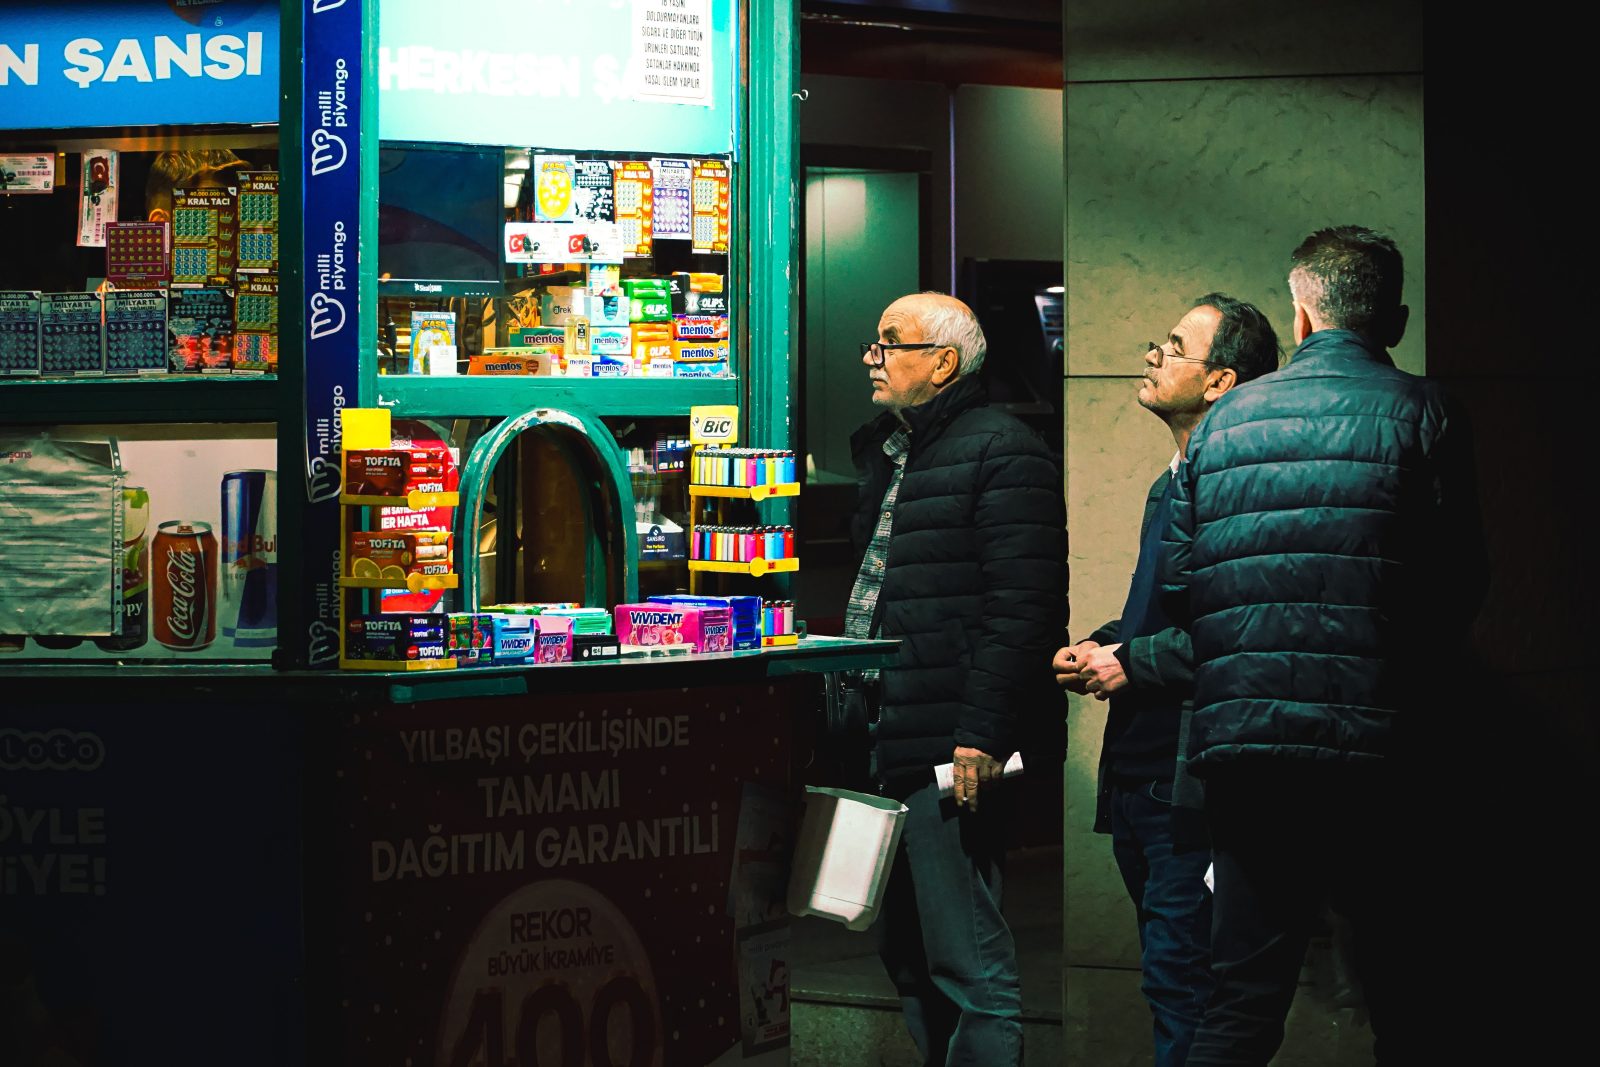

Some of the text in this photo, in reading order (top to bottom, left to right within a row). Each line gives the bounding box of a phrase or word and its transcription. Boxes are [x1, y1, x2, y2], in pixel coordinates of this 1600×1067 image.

[63, 31, 263, 88] ŞANSI
[318, 58, 348, 128] milli piyango
[252, 182, 275, 190] KRAL
[187, 198, 230, 206] KRAL TACI
[317, 221, 347, 290] milli piyango
[250, 284, 273, 292] KRAL
[524, 332, 565, 344] mentos
[594, 335, 619, 345] mentos
[680, 325, 714, 336] mentos
[681, 348, 715, 359] mentos
[485, 360, 522, 372] mentos
[594, 363, 620, 372] mentos
[316, 418, 329, 455] milli
[398, 514, 429, 527] HAFTA
[317, 583, 329, 619] milli
[400, 708, 690, 766] YILBAŞI ÇEKİLİŞİNDE
[477, 768, 621, 818] TAMAMI
[371, 801, 719, 883] DAĞITIM GARANTİLİ
[510, 906, 592, 945] REKOR
[487, 944, 614, 977] BÜYÜK İKRAMİYE
